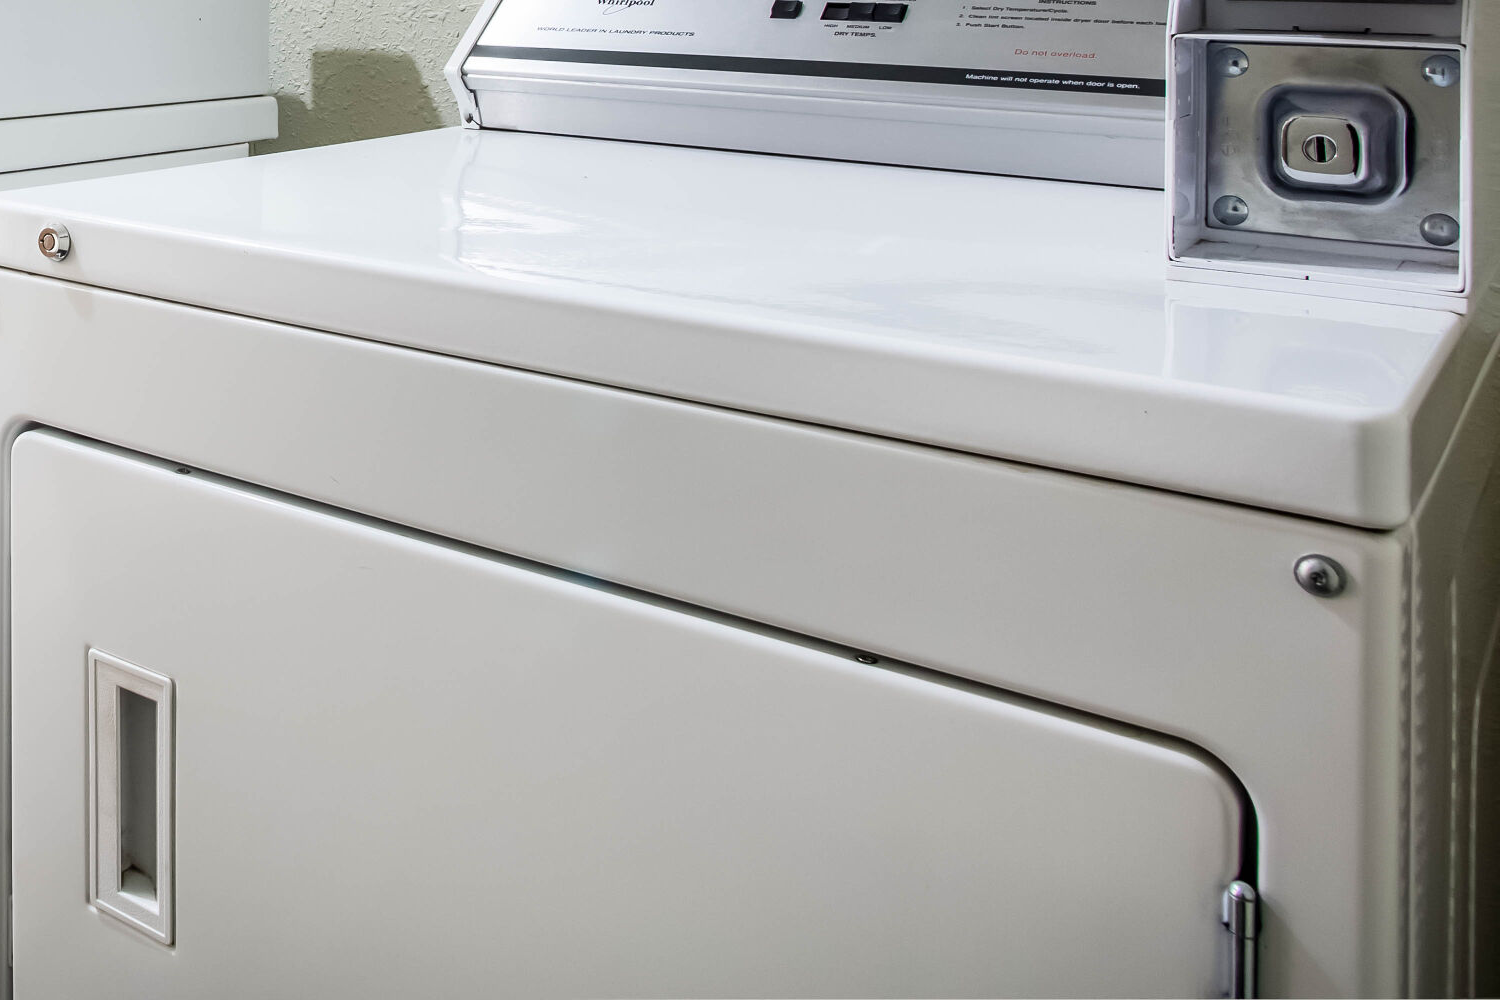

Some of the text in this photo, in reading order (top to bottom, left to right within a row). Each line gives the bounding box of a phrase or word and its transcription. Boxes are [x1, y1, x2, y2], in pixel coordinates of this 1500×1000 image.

[1014, 48, 1029, 56] Do
[965, 73, 999, 81] Machine
[1029, 77, 1060, 85] operate
[1116, 82, 1141, 90] open.
